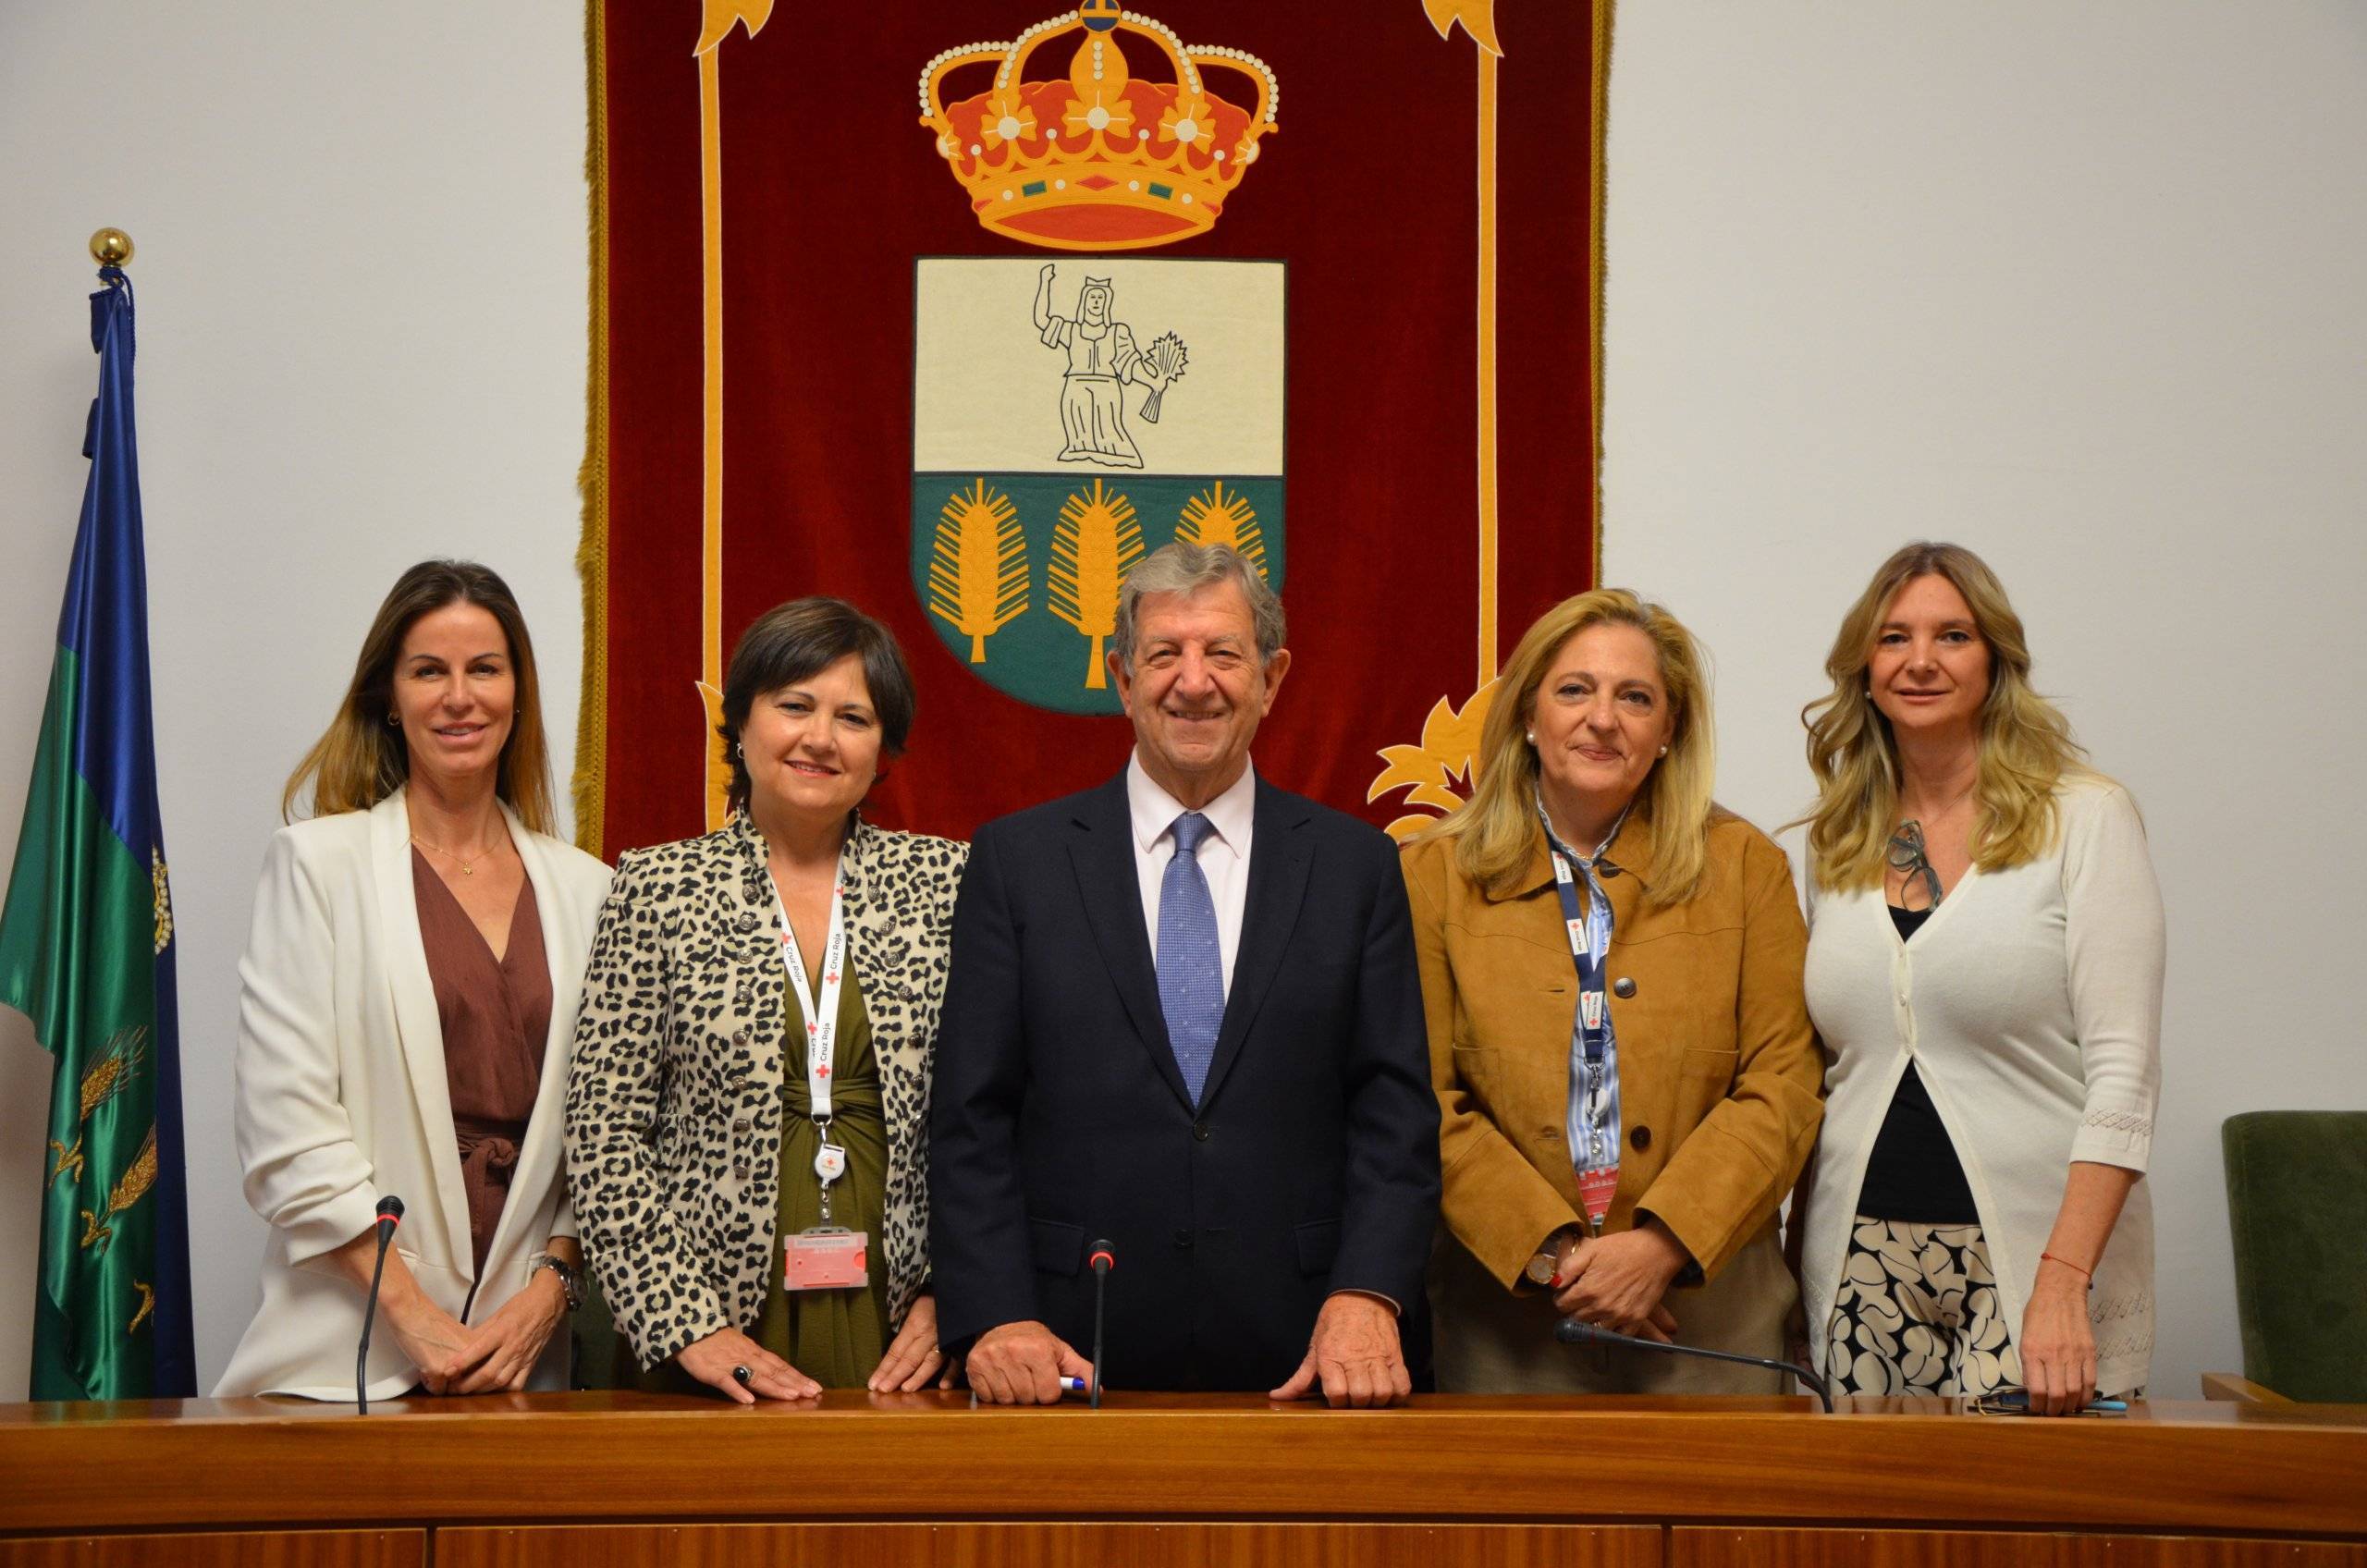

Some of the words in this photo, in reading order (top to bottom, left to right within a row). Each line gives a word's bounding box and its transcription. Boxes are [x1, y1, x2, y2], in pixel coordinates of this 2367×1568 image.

[833, 933, 842, 949] Roja
[786, 947, 795, 963] Cruz
[792, 965, 802, 982] Roja
[830, 952, 839, 969] Cruz
[821, 1023, 830, 1040] Roja
[820, 1041, 828, 1061] Cruz
